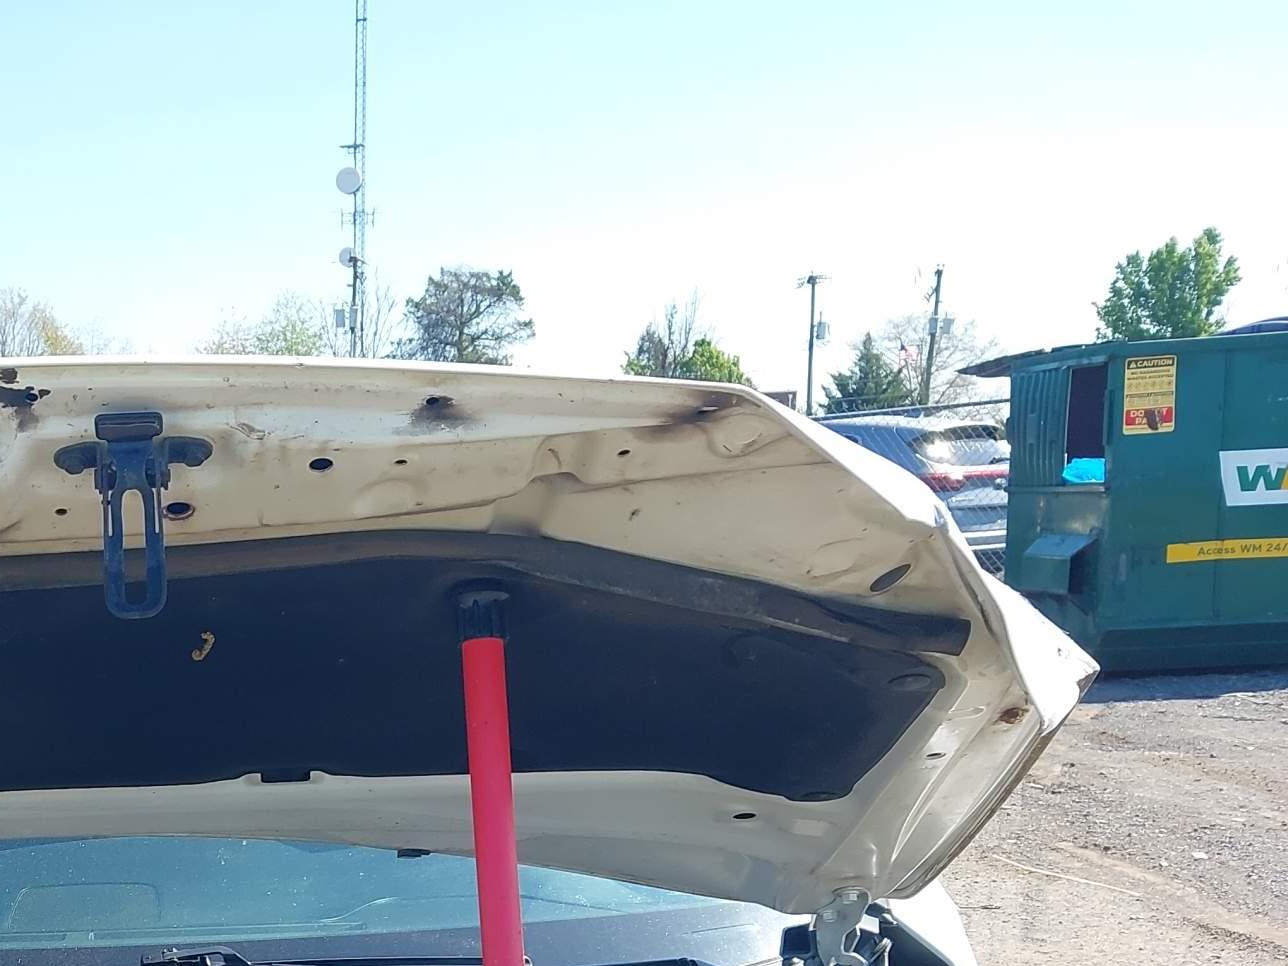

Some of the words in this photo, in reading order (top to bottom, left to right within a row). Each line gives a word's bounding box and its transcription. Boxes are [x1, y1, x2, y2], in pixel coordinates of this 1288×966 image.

[1137, 358, 1173, 367] CAUTION
[1130, 410, 1145, 418] DO
[1236, 464, 1288, 492] W
[1197, 545, 1236, 556] Access
[1240, 543, 1262, 553] WM
[1266, 543, 1288, 552] 24/
